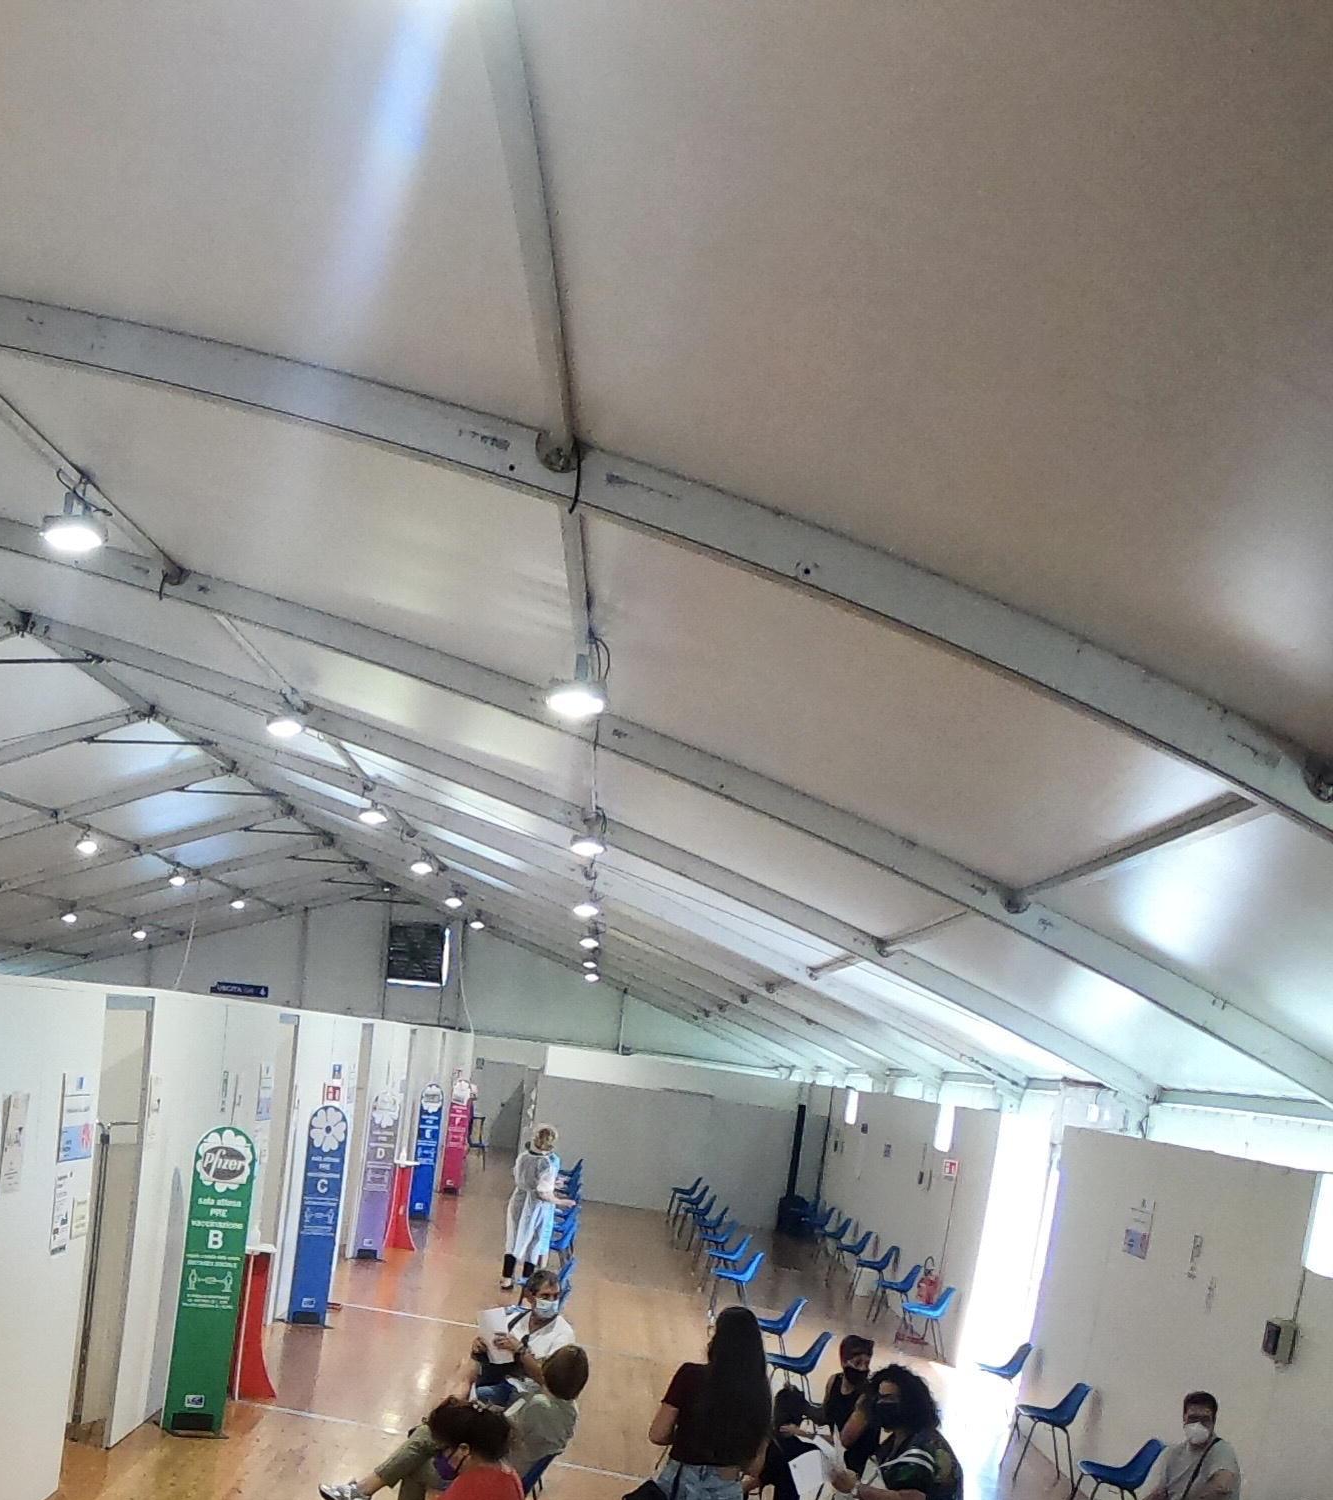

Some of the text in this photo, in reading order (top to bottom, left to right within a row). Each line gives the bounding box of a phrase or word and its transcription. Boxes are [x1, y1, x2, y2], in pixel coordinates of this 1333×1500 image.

[376, 1148, 385, 1159] D
[203, 1148, 245, 1179] Pfizer
[317, 1179, 328, 1193] C
[208, 1230, 223, 1249] B
